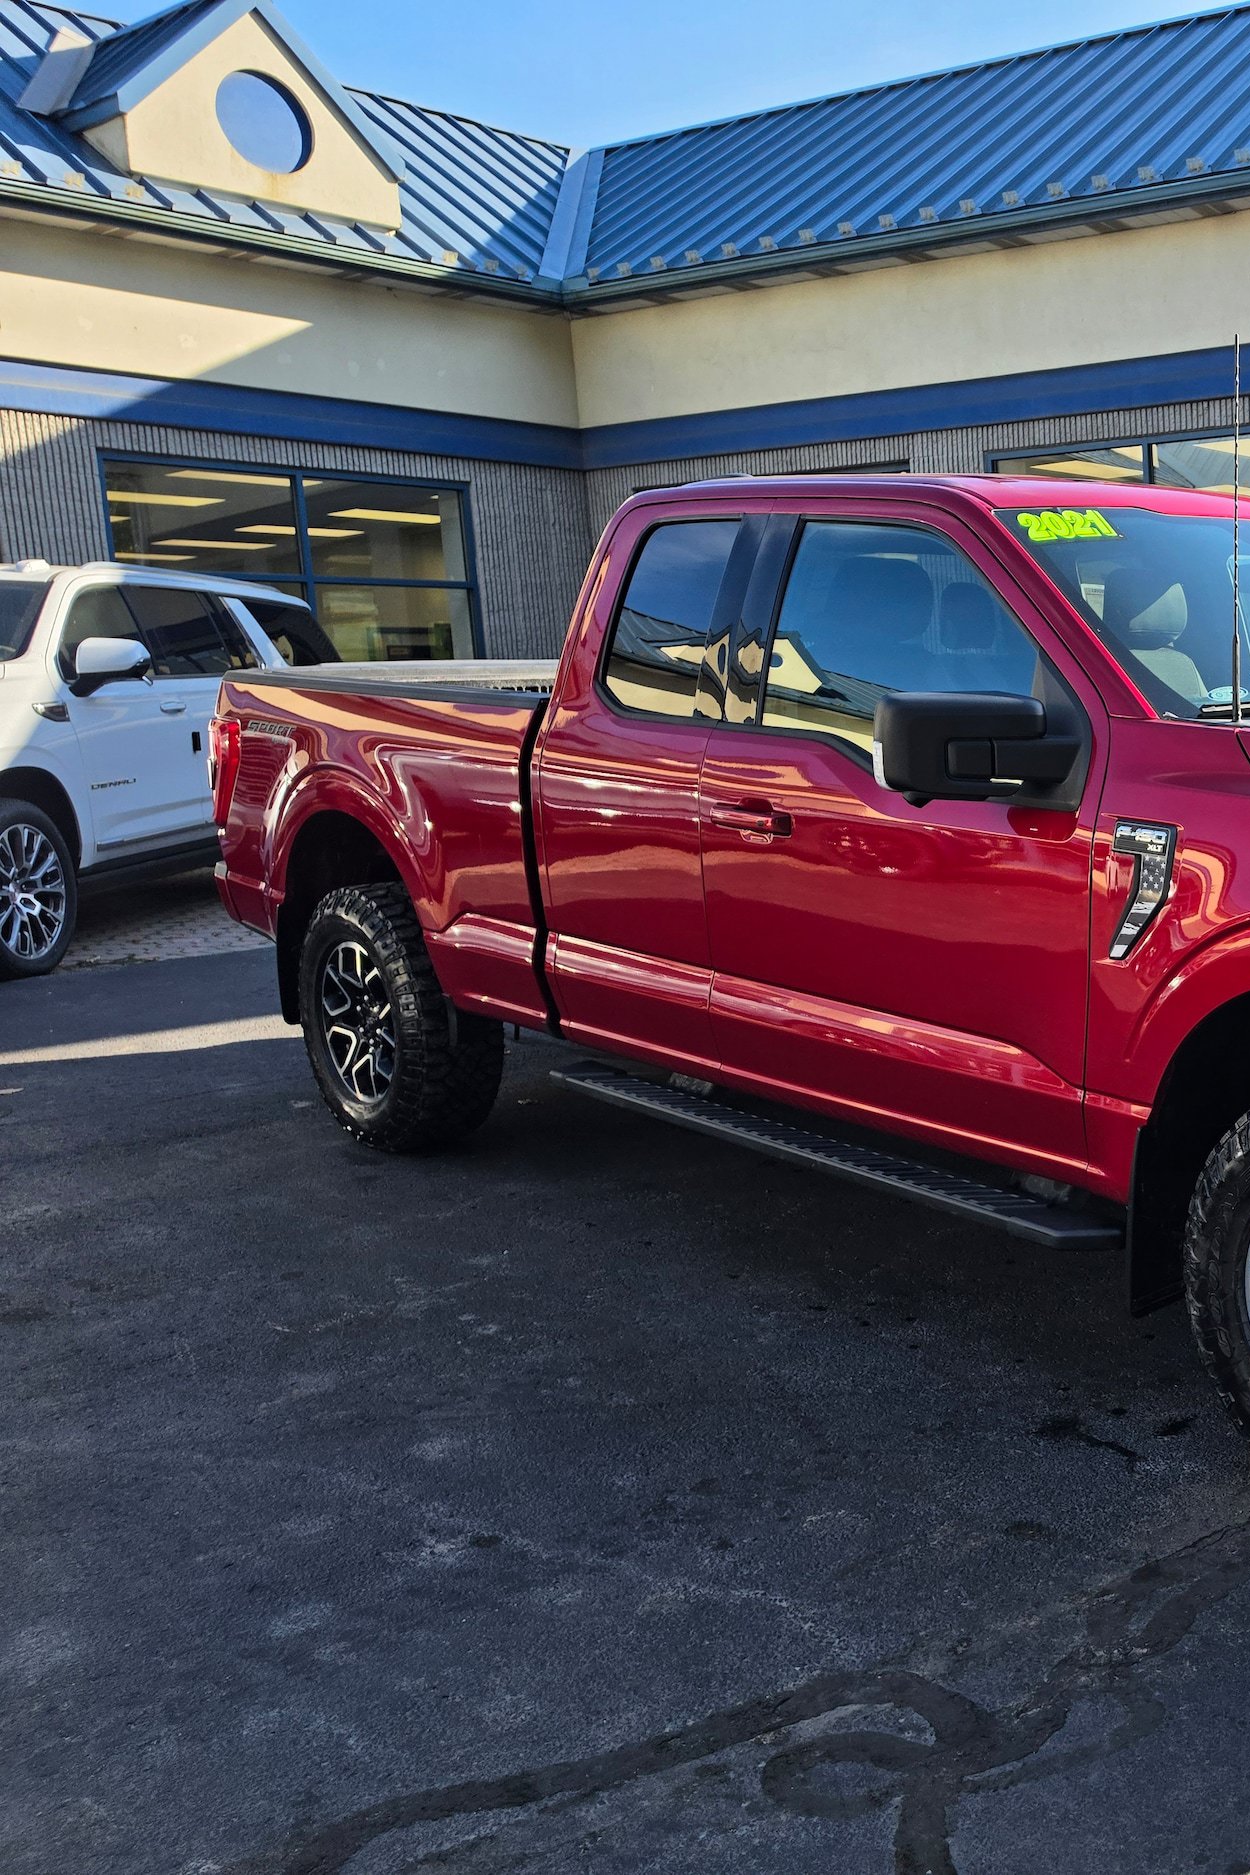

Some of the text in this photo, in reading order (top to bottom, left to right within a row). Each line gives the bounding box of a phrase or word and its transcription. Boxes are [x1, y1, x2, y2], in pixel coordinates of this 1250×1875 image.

[1017, 510, 1119, 541] 2021
[248, 720, 297, 737] SPORT
[91, 778, 137, 790] DENALI
[1116, 826, 1167, 843] F-150
[1147, 843, 1164, 852] XLT
